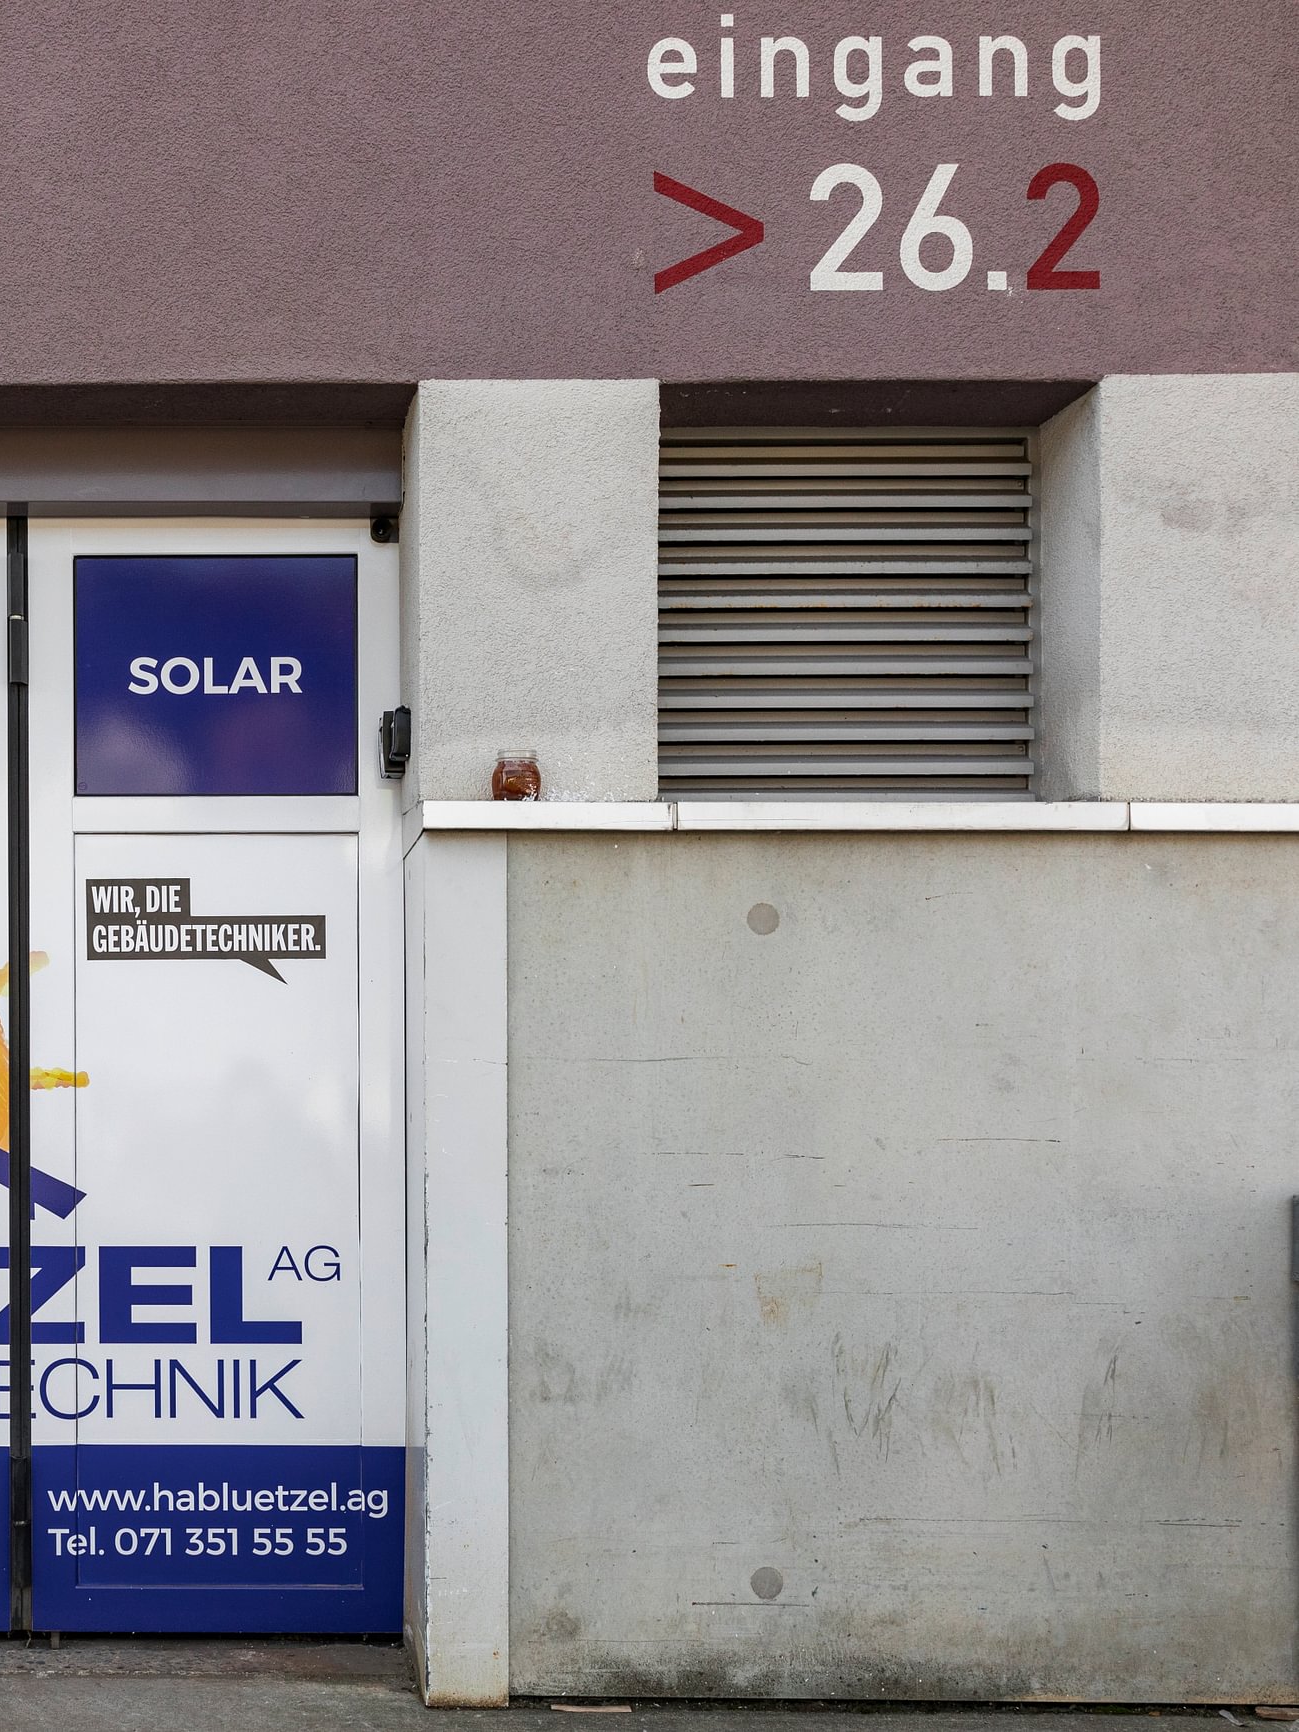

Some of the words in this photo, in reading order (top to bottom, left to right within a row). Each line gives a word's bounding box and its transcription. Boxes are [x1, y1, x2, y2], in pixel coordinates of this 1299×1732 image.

[646, 13, 1101, 122] eingang
[809, 162, 1100, 292] 26.2
[128, 656, 303, 695] SOLAR
[91, 885, 141, 918] WIR,
[145, 885, 182, 913] DIE
[92, 919, 321, 953] GEBÄUDETECHNIKER.
[268, 1245, 341, 1281] AG
[47, 1482, 388, 1519] www.habluetzel.ag
[47, 1526, 105, 1556] Tel.
[114, 1527, 172, 1556] 071
[185, 1528, 238, 1556] 351
[252, 1528, 294, 1556] 55
[305, 1527, 347, 1556] 55
